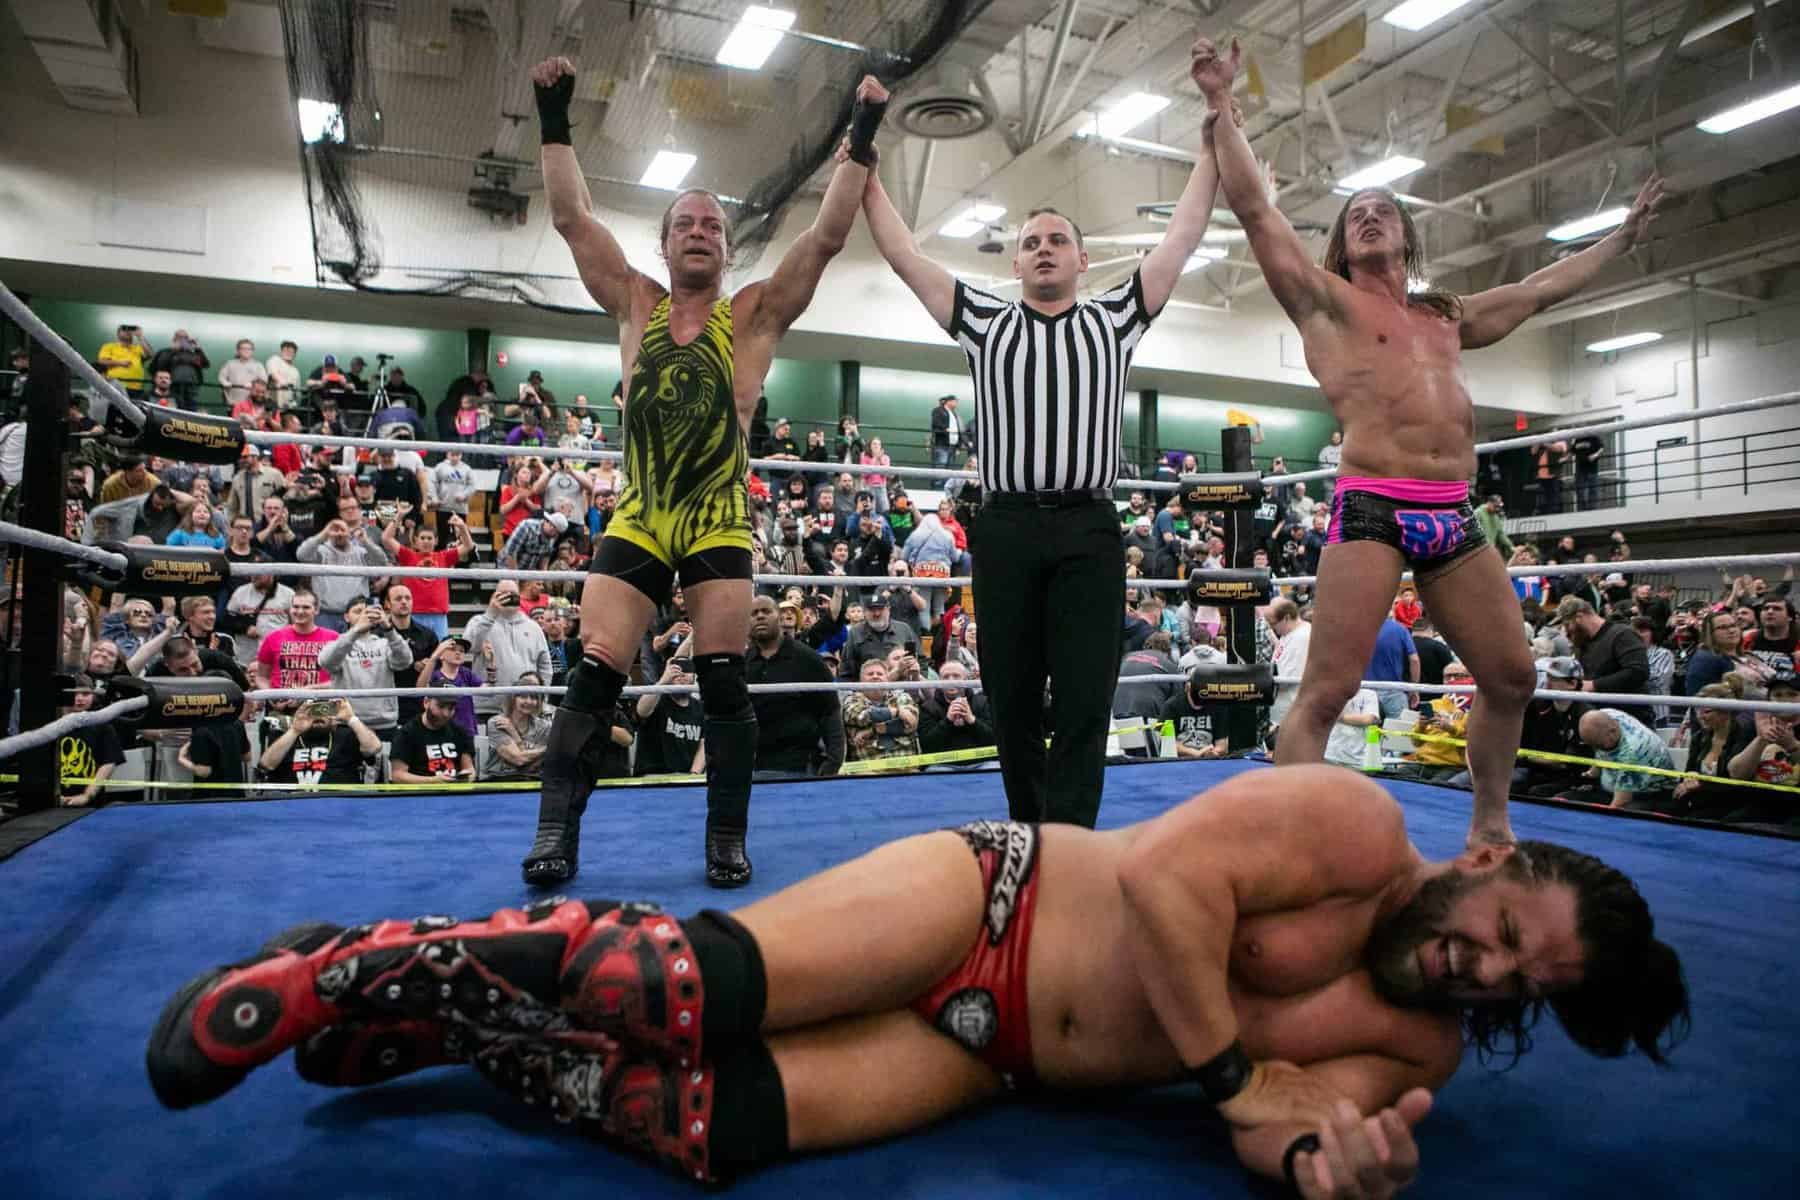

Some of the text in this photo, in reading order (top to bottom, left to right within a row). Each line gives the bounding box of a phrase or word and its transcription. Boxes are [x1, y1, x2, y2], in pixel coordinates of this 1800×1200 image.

[284, 655, 317, 669] THAN
[294, 746, 329, 762] EC
[426, 743, 458, 758] EC
